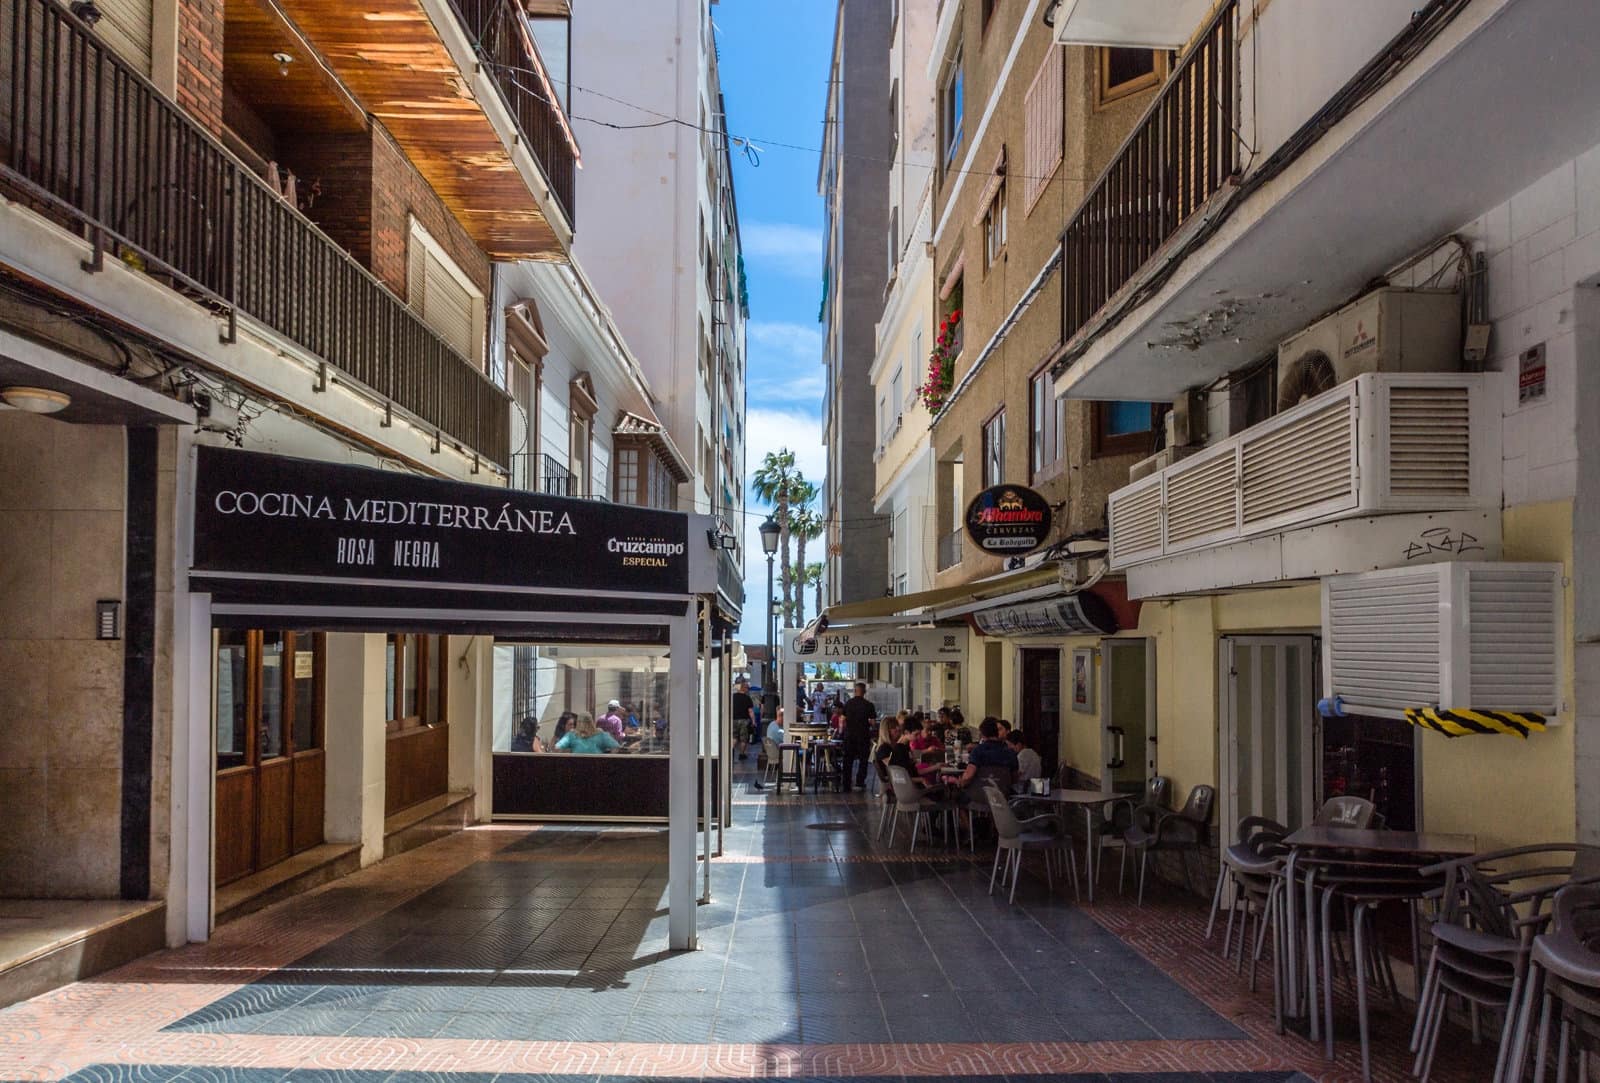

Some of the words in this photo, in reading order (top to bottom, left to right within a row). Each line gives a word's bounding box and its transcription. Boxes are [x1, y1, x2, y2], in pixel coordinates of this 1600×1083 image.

[214, 490, 337, 520] COCINA
[343, 498, 577, 535] MEDITERRÁNEA
[976, 507, 1043, 525] Alhambra
[985, 527, 1035, 535] CERVEZAS
[337, 537, 375, 566] ROSA
[393, 540, 440, 568] NEGRA
[607, 537, 684, 557] Cruzcampo
[623, 556, 668, 567] ESPECIAL
[825, 635, 851, 645] BAR
[825, 645, 841, 656] LA
[847, 644, 920, 656] BODEGUITA
